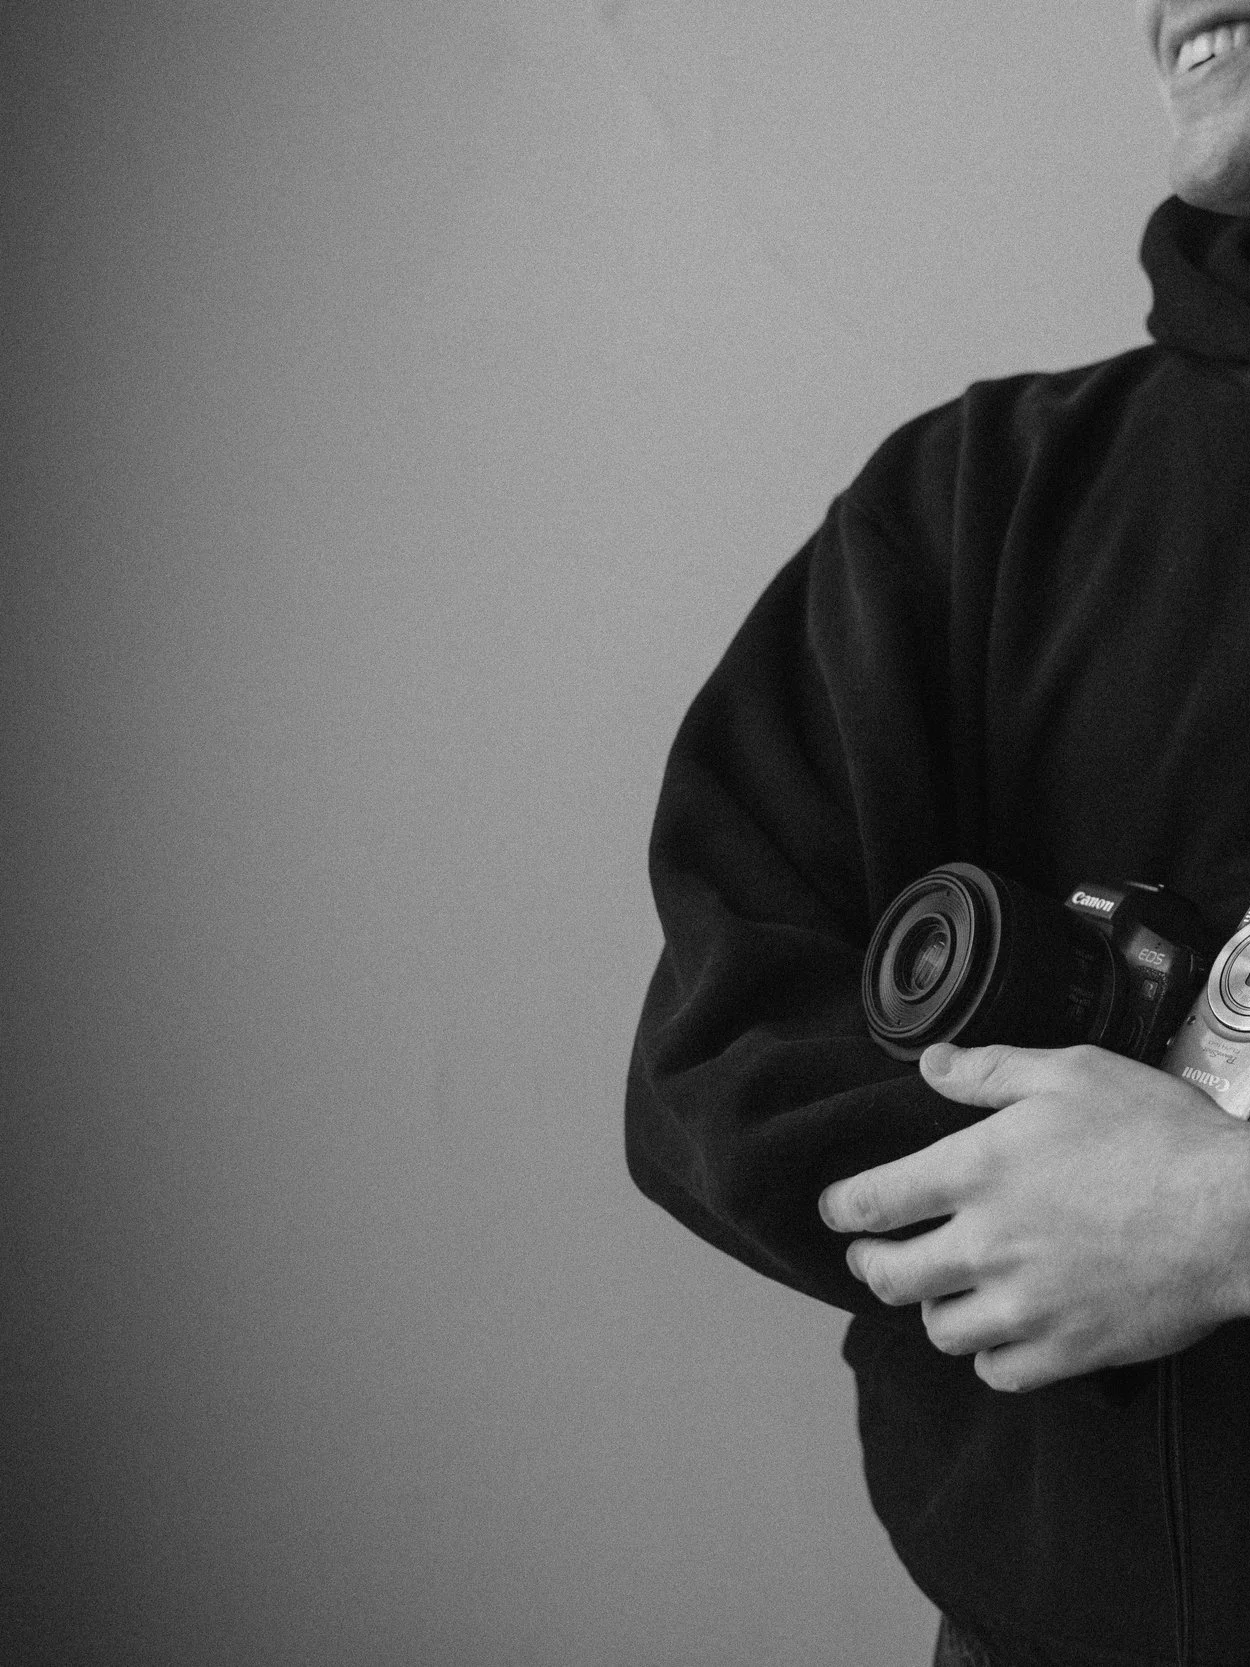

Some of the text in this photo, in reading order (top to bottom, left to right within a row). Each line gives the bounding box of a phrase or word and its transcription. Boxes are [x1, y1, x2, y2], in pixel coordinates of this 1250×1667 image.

[1072, 891, 1115, 912] Canon
[1138, 948, 1165, 965] EOS
[1182, 1066, 1230, 1092] Canon
